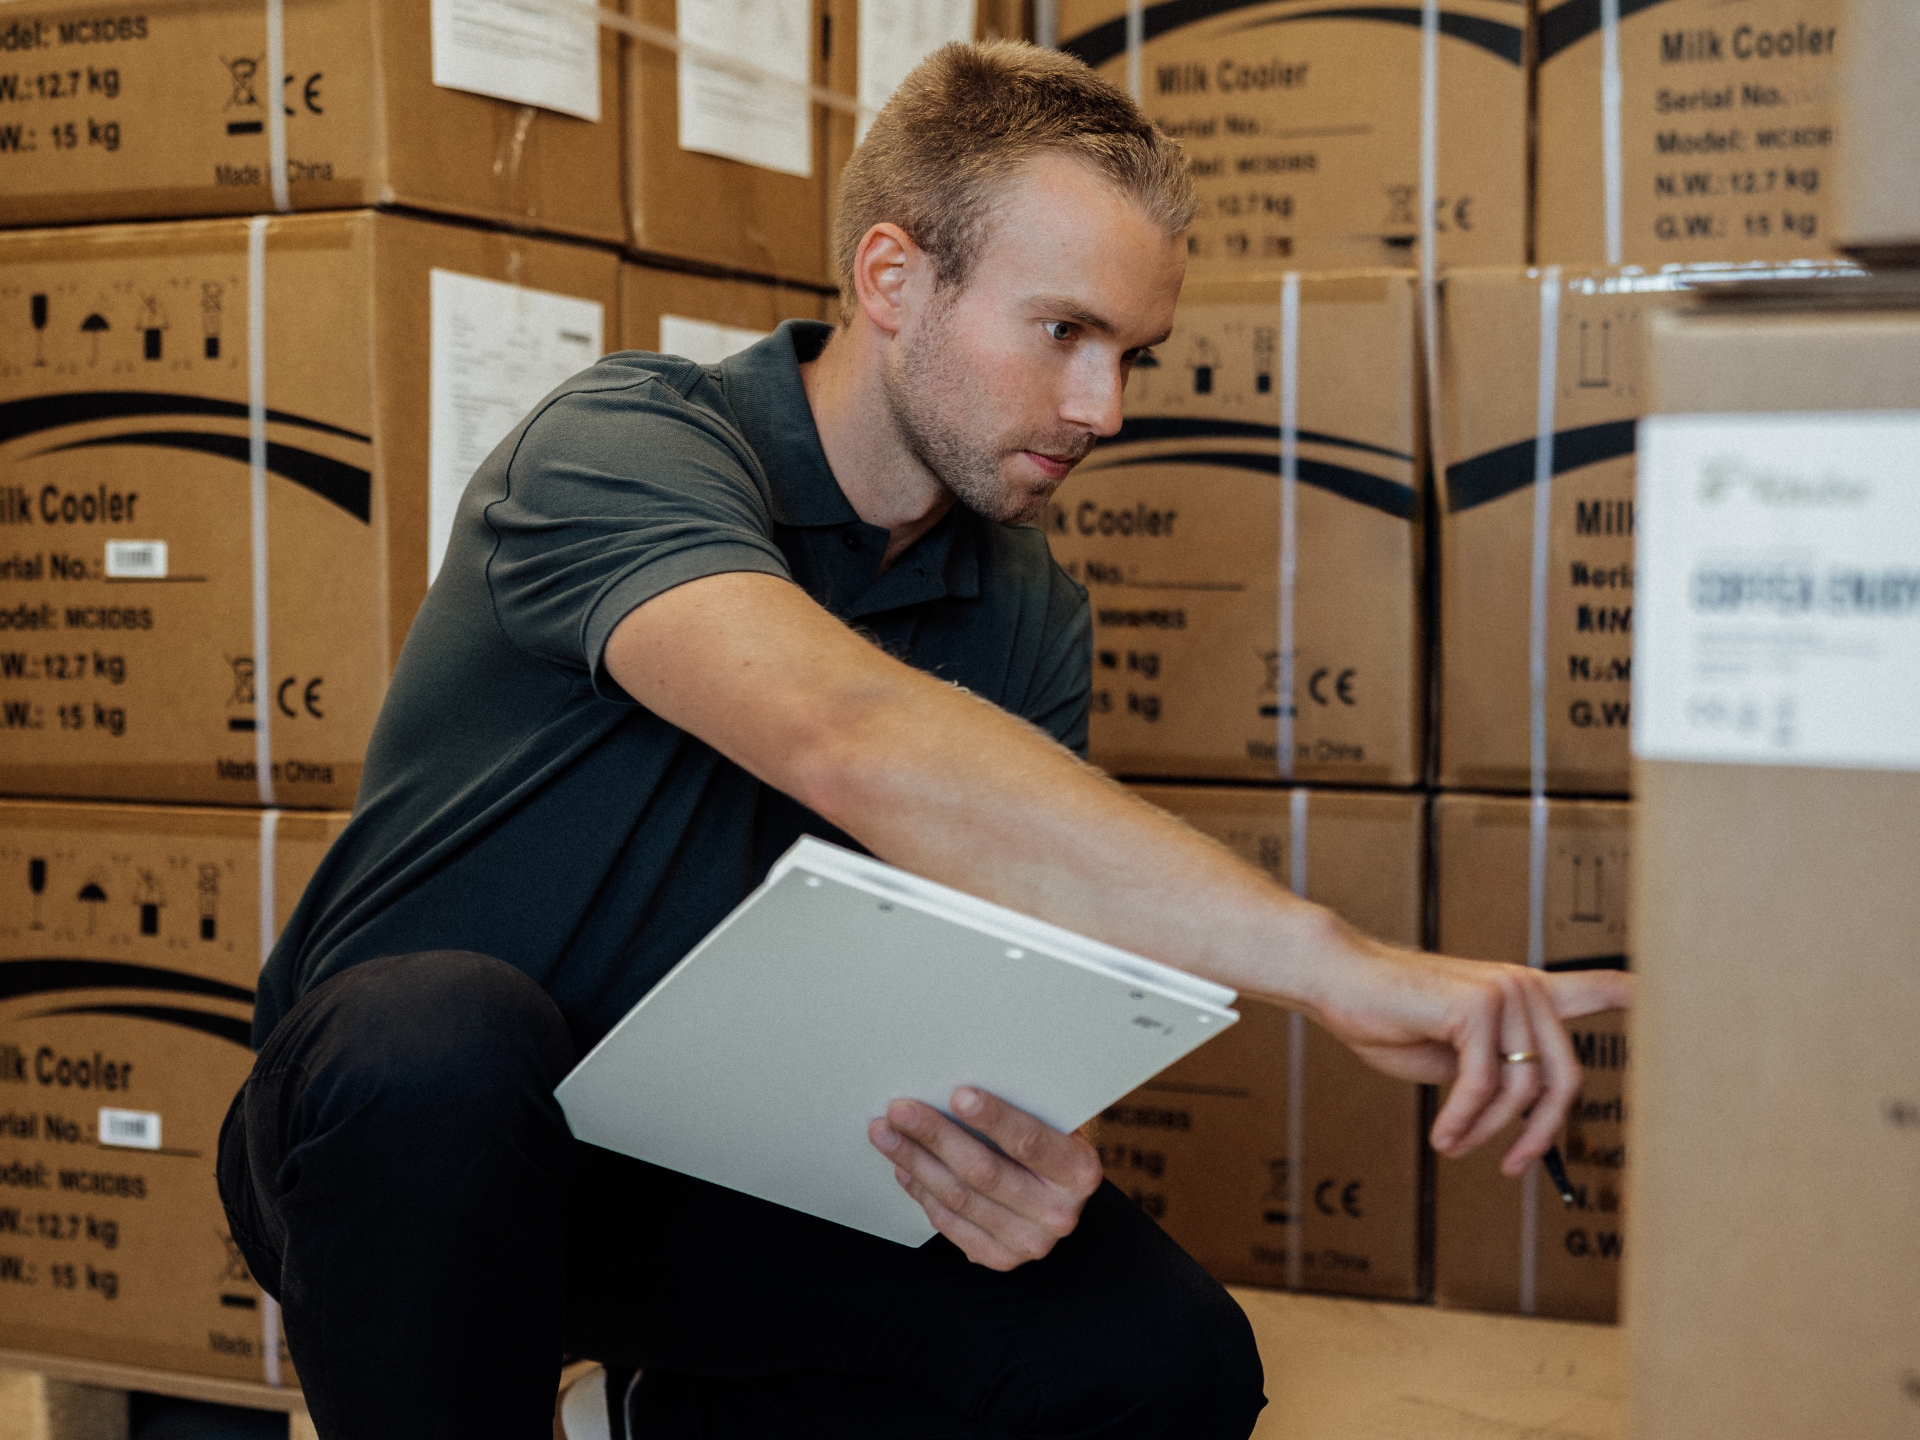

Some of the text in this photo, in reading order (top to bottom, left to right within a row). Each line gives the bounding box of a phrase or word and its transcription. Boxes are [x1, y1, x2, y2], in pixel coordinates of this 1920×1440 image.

[1732, 21, 1837, 60] Cooler
[87, 66, 120, 98] kg
[51, 121, 78, 149] 15
[87, 117, 120, 151] kg
[39, 483, 137, 524] Cooler
[1076, 501, 1177, 537] Cooler
[93, 650, 125, 685] kg
[57, 703, 84, 731] 15
[93, 701, 126, 737] kg
[35, 1046, 133, 1092] Cooler
[86, 1214, 119, 1250] kg
[86, 1262, 119, 1300] kg
